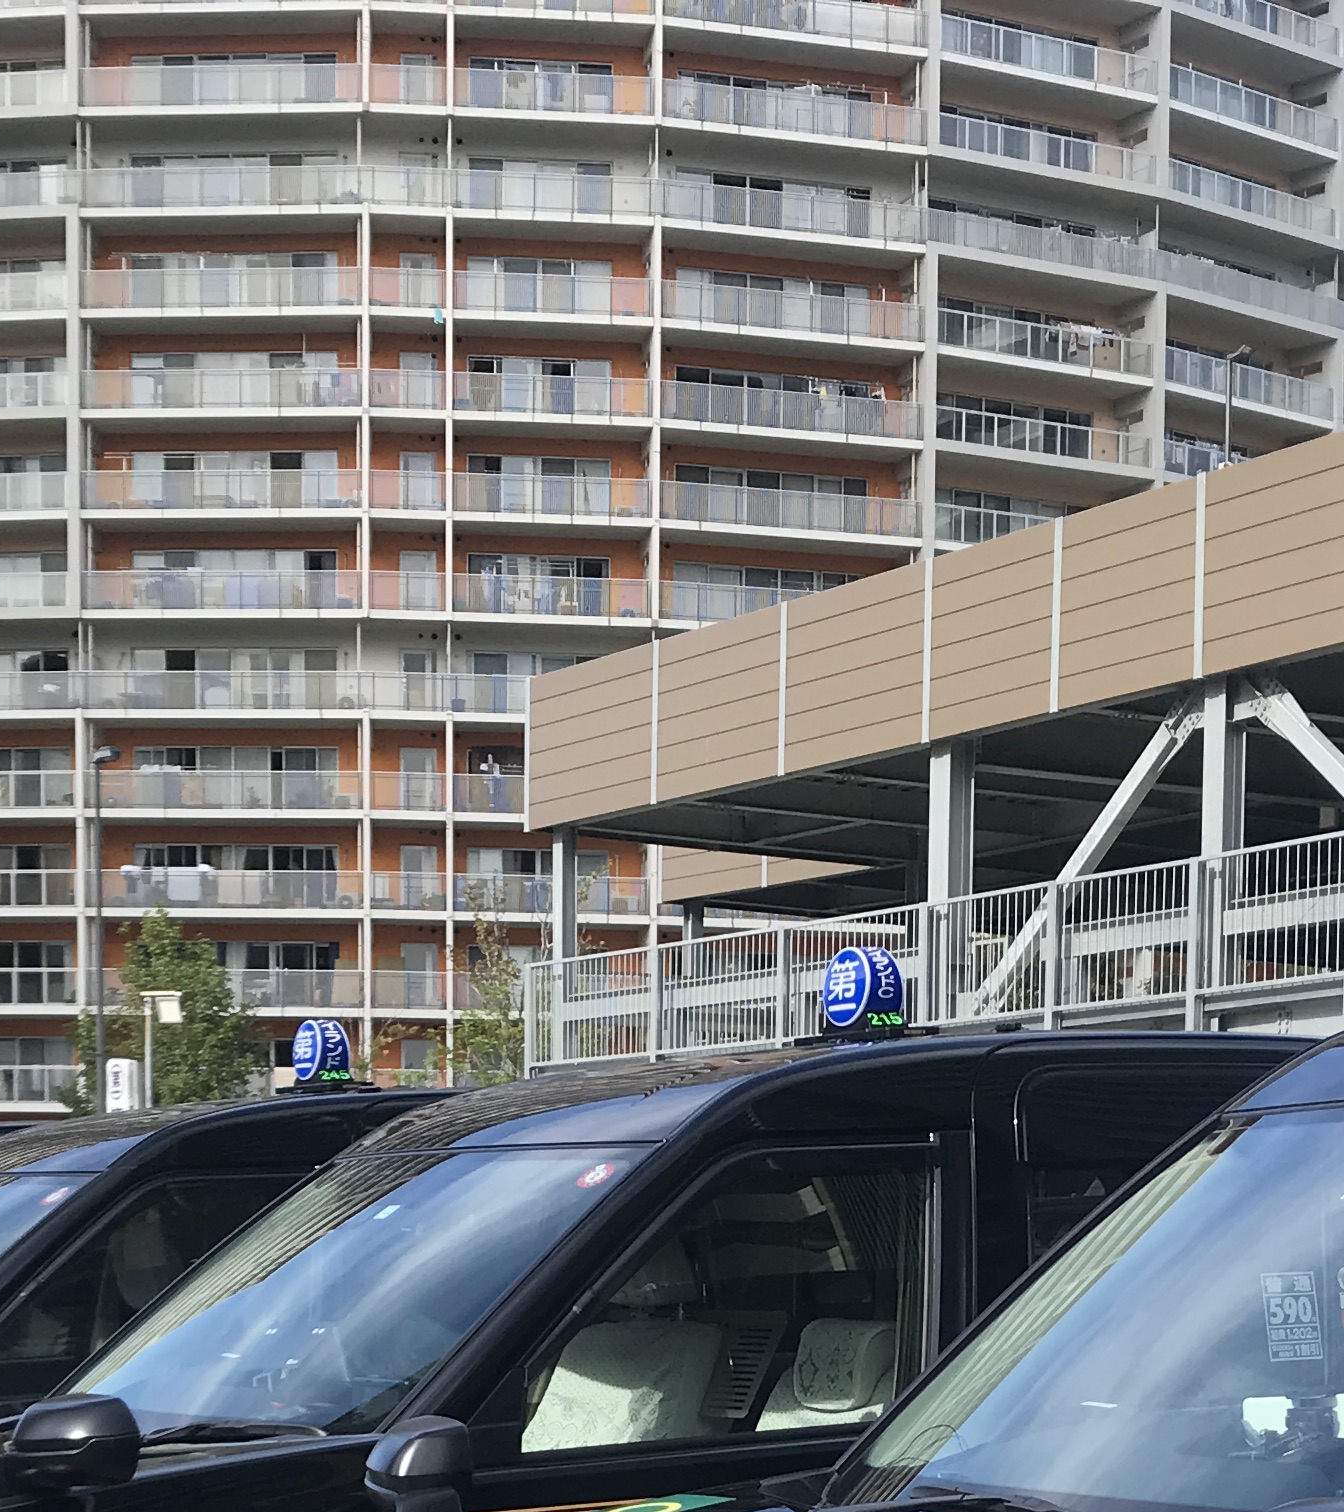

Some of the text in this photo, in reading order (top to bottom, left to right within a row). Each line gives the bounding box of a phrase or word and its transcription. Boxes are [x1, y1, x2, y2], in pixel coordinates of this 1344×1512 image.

[827, 958, 860, 1013] 第一
[867, 1012, 903, 1025] 215
[294, 1030, 315, 1068] 第一
[318, 1070, 351, 1080] 245
